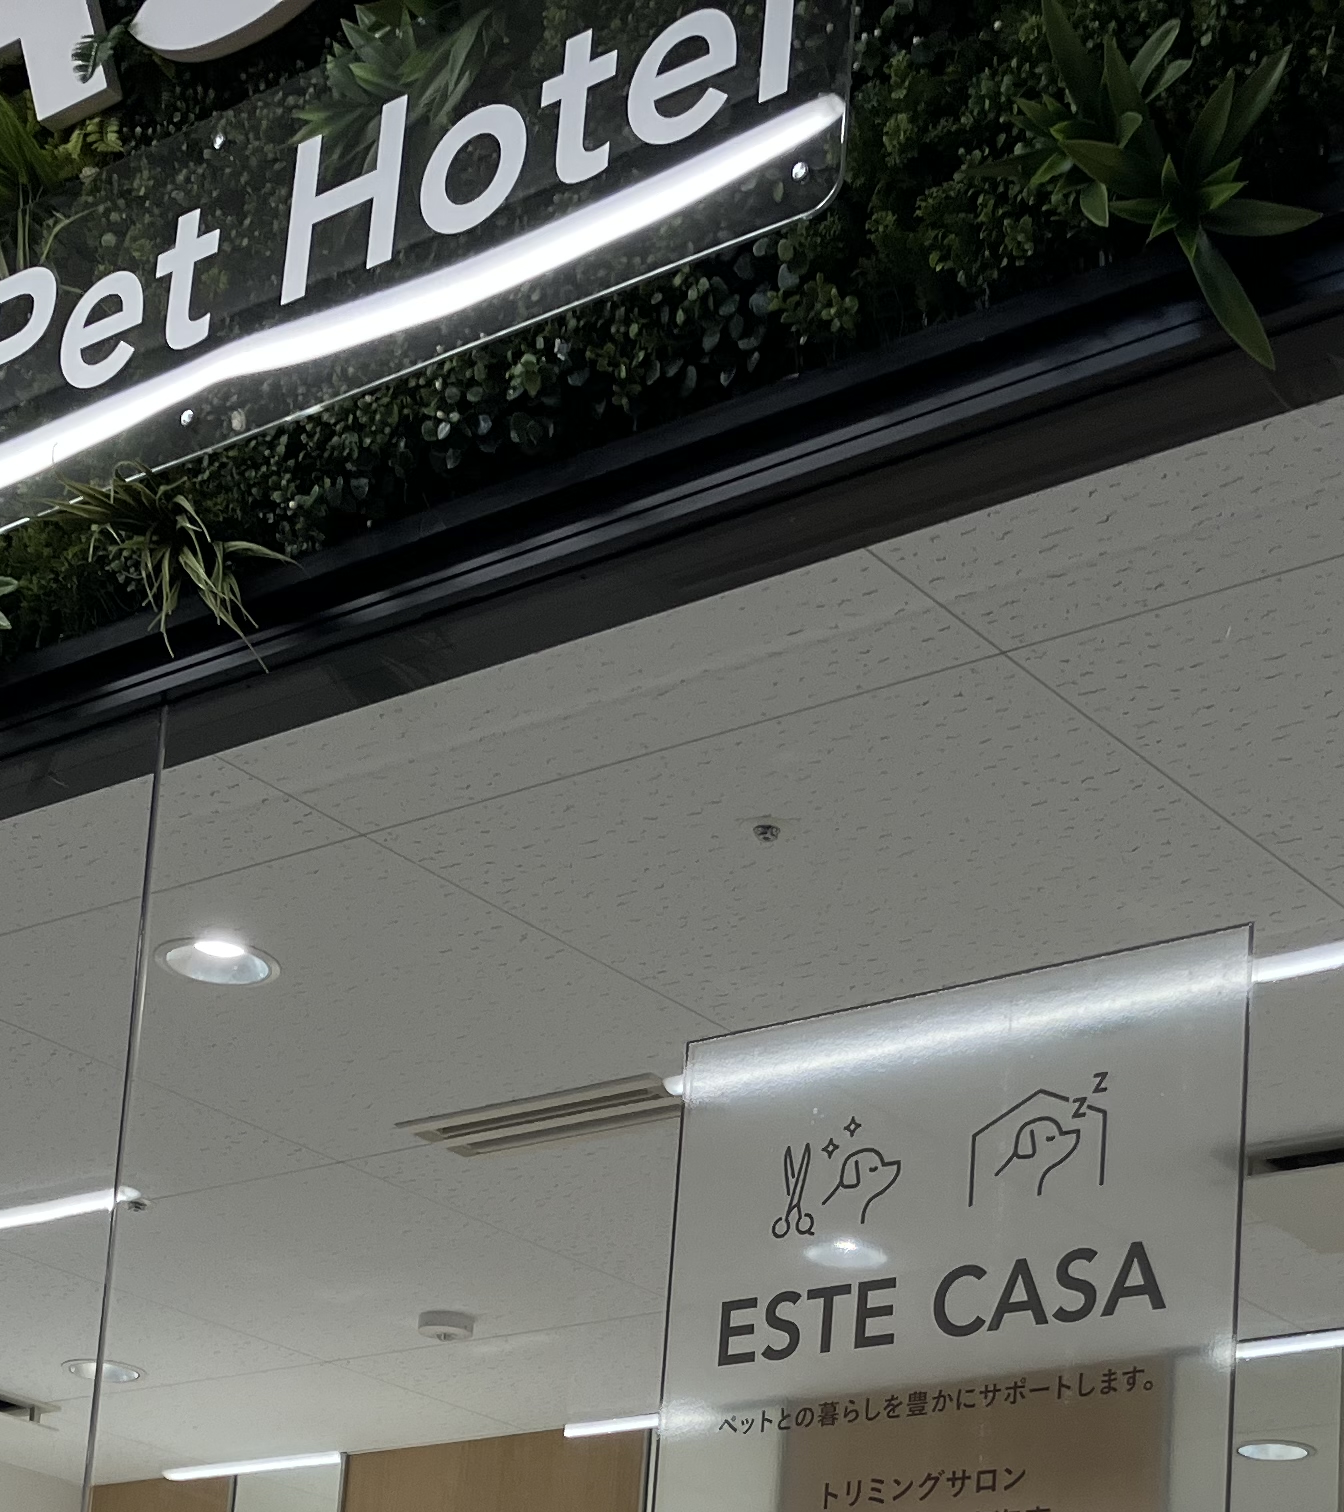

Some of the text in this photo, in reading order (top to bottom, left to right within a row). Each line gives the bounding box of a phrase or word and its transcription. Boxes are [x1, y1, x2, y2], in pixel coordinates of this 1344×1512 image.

[280, 0, 794, 305] Hotel
[717, 1240, 1167, 1368] ESTE CASA
[718, 1366, 1154, 1435] ペットとの暮らしを豊かにサポートします。
[822, 1467, 1026, 1510] トリミングサロン
